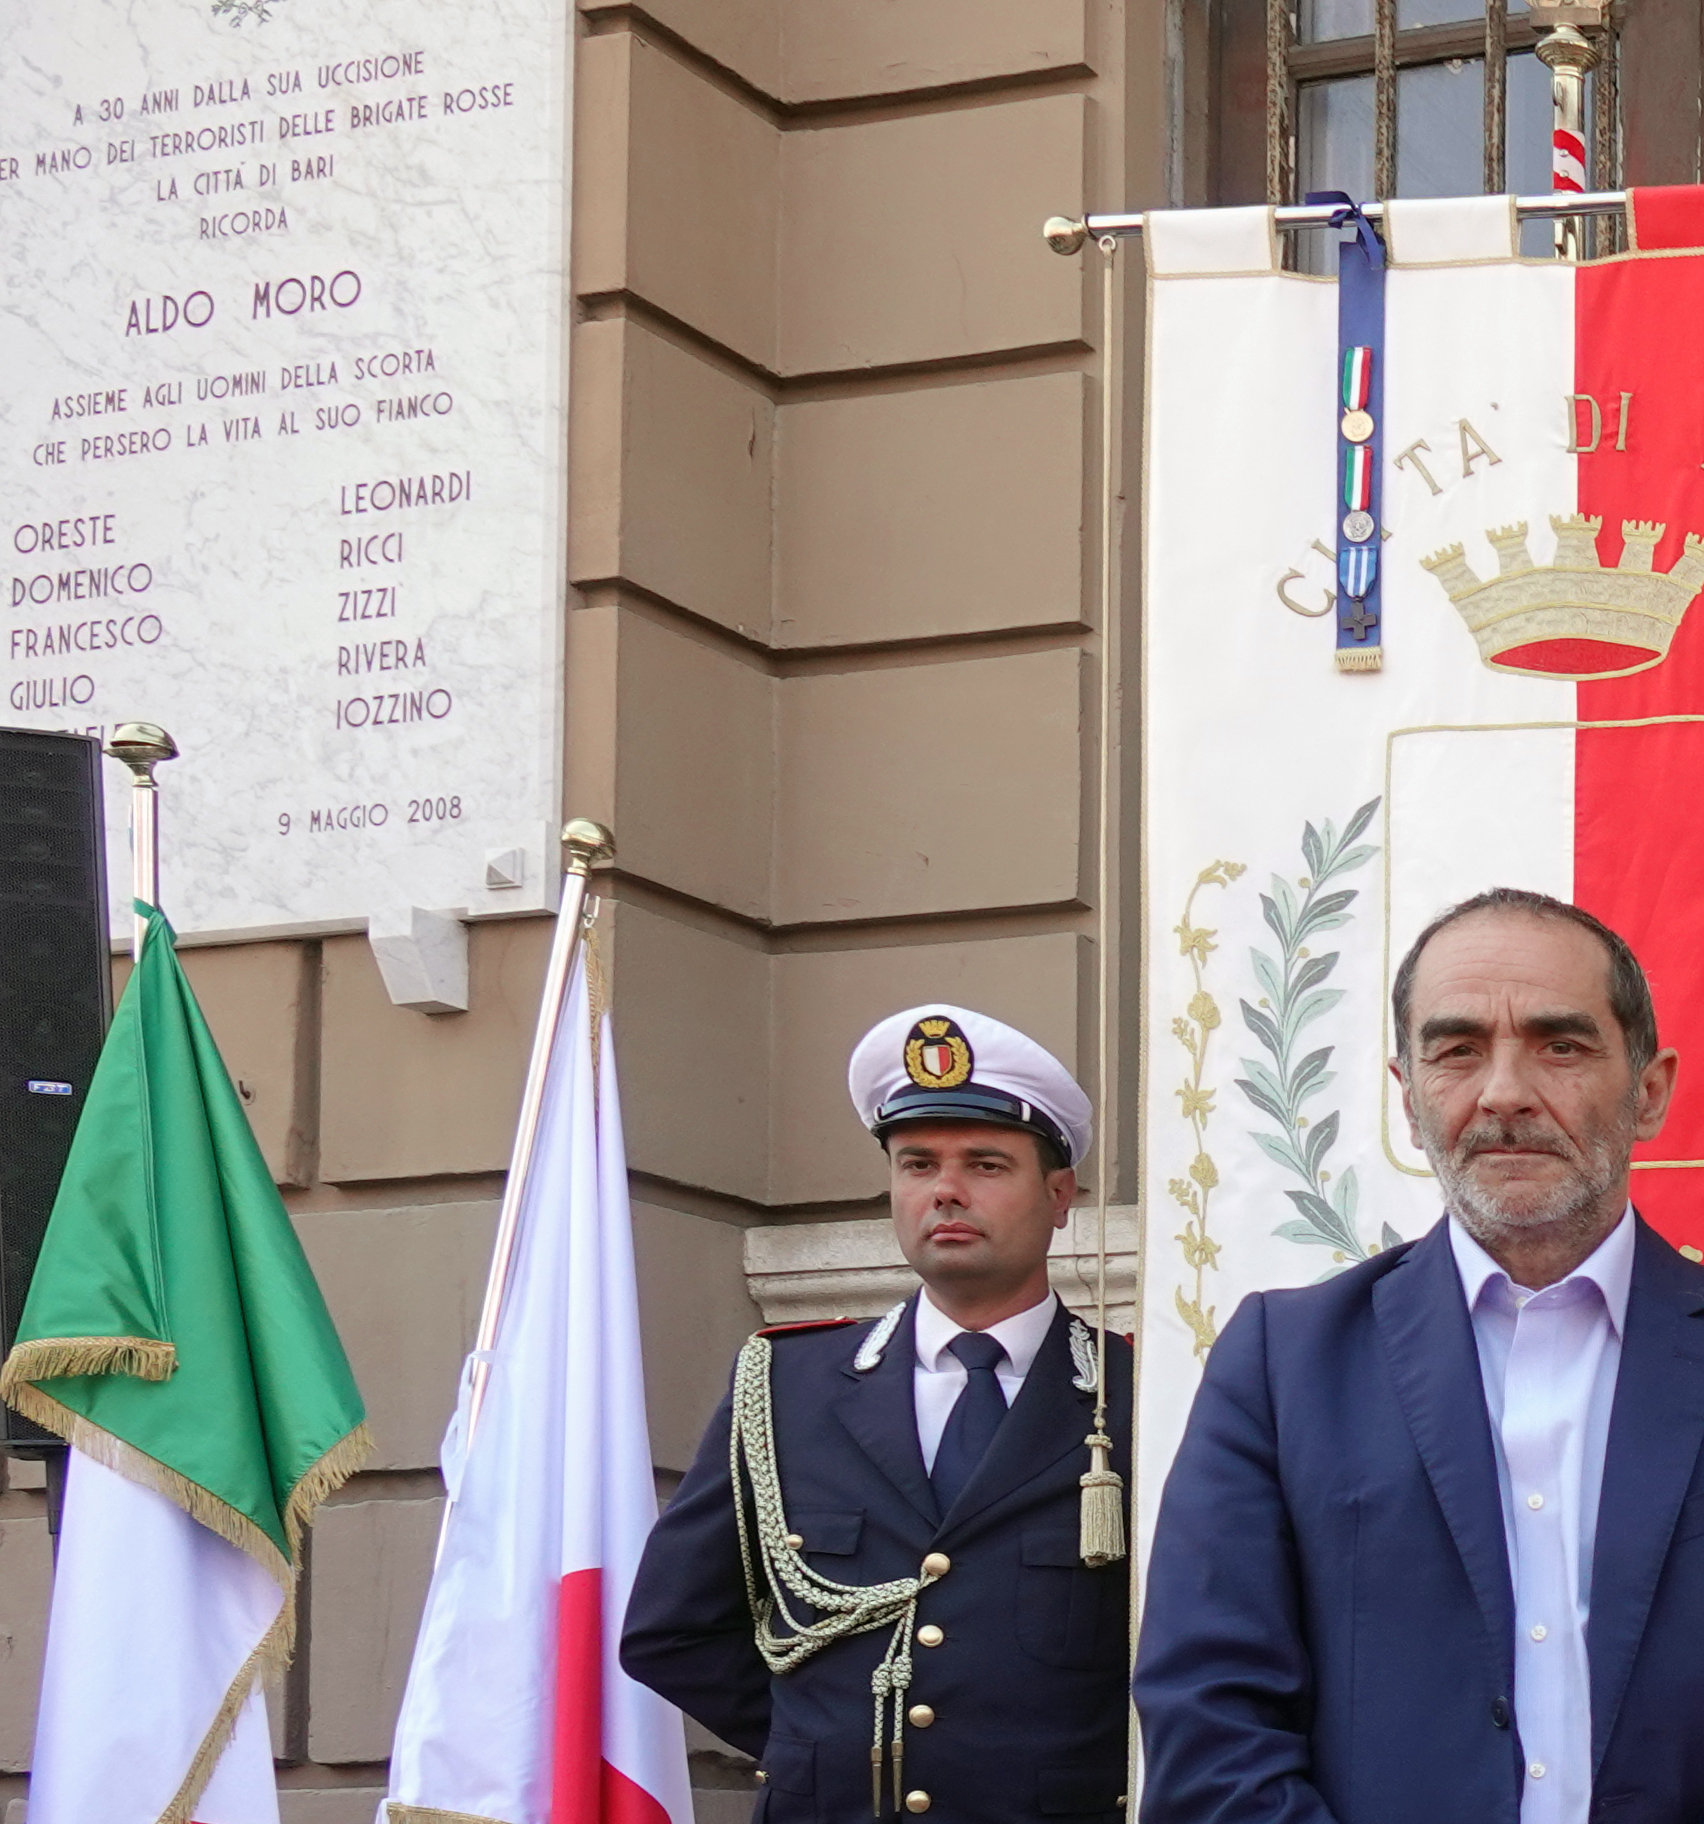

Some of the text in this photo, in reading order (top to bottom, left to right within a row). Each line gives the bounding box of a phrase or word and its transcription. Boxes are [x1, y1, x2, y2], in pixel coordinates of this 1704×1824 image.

[74, 50, 425, 126] A 30 ANNI DALLA SUA UCCISIONE
[0, 82, 515, 181] ER MANO DEI TERRORISTI DELLE BRIGATE ROSSE
[156, 178, 179, 202] LA
[259, 162, 278, 187] DI
[291, 154, 334, 183] BARI
[199, 207, 289, 240] RICORDA
[125, 269, 362, 337] ALDO MORO
[51, 348, 437, 422] ASSIEME AGLI UOMINI DELLA SCORTA
[33, 391, 454, 466] CHE PERSERO LA VITA AL SUO FIANCO
[1564, 391, 1634, 455] DI
[340, 470, 472, 516] LEONARDI
[13, 514, 116, 554] ORESTE
[339, 532, 404, 569] RICCI
[11, 563, 153, 607] DOMENICO
[337, 586, 397, 623] ZIZZI
[10, 614, 163, 660] FRANCESCO
[337, 637, 427, 677] RIVERA
[10, 674, 95, 711] GIULIO
[336, 688, 453, 730] IOZZINO
[278, 795, 464, 836] 9 MAGGIO 2008
